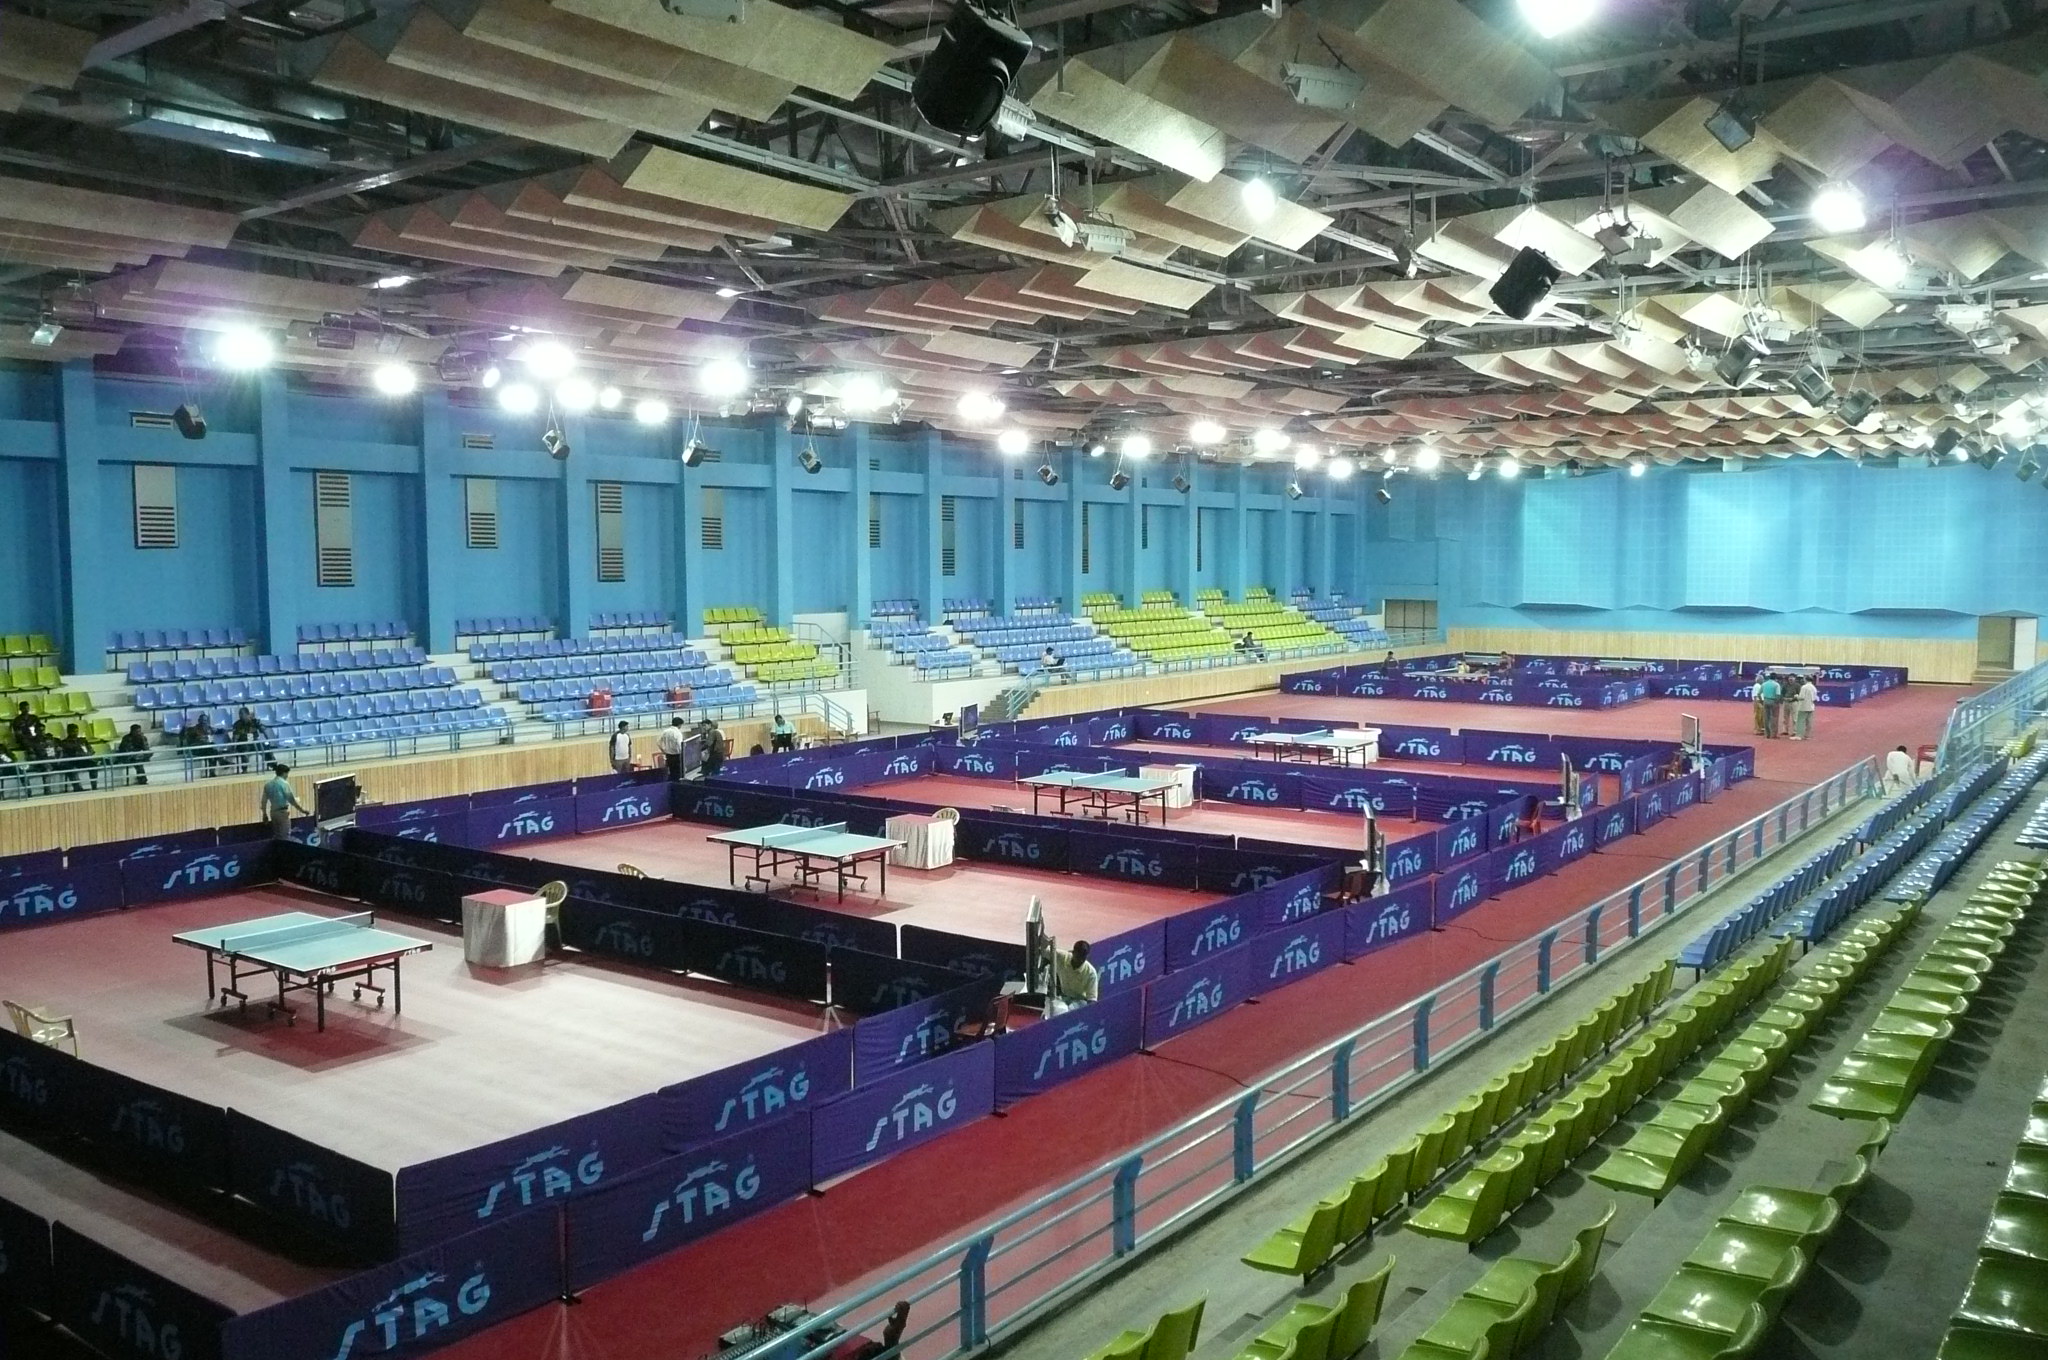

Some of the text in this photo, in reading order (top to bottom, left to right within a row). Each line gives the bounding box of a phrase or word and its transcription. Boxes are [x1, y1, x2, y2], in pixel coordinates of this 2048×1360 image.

[1293, 682, 1321, 691] STAG
[1352, 686, 1383, 695] STAG
[1413, 689, 1446, 699] STAG
[1480, 692, 1513, 702] STAG
[1665, 687, 1700, 697] STAG
[1547, 697, 1582, 706] STAG
[1055, 735, 1078, 747] STAG
[1103, 727, 1127, 742] STAG
[1153, 727, 1191, 739] STAG
[1395, 741, 1440, 756] STAG
[1487, 750, 1536, 762] STAG
[884, 760, 918, 775] STAG
[954, 758, 994, 773] STAG
[806, 772, 844, 790] STAG
[1227, 785, 1279, 801] STAG
[602, 801, 652, 822] STAG
[693, 800, 734, 817] STAG
[497, 815, 554, 839] STAG
[1604, 817, 1624, 840] STAG
[983, 839, 1040, 859] STAG
[1451, 832, 1477, 857] STAG
[1560, 832, 1584, 857] STAG
[163, 860, 240, 889] STAG
[1100, 854, 1162, 877] STAG
[1390, 854, 1421, 880] STAG
[1505, 856, 1535, 882] STAG
[1450, 879, 1478, 909] STAG
[1282, 891, 1320, 921] STAG
[1366, 909, 1410, 943] STAG
[1191, 920, 1240, 956] STAG
[717, 952, 787, 982] STAG
[1097, 952, 1145, 984] STAG
[1270, 941, 1320, 978] STAG
[1169, 983, 1222, 1027] STAG
[1034, 1028, 1106, 1080] STAG
[715, 1072, 809, 1131] STAG
[866, 1089, 956, 1152] STAG
[478, 1151, 604, 1218] STAG
[642, 1164, 760, 1242] STAG
[334, 1273, 491, 1360] STAG
